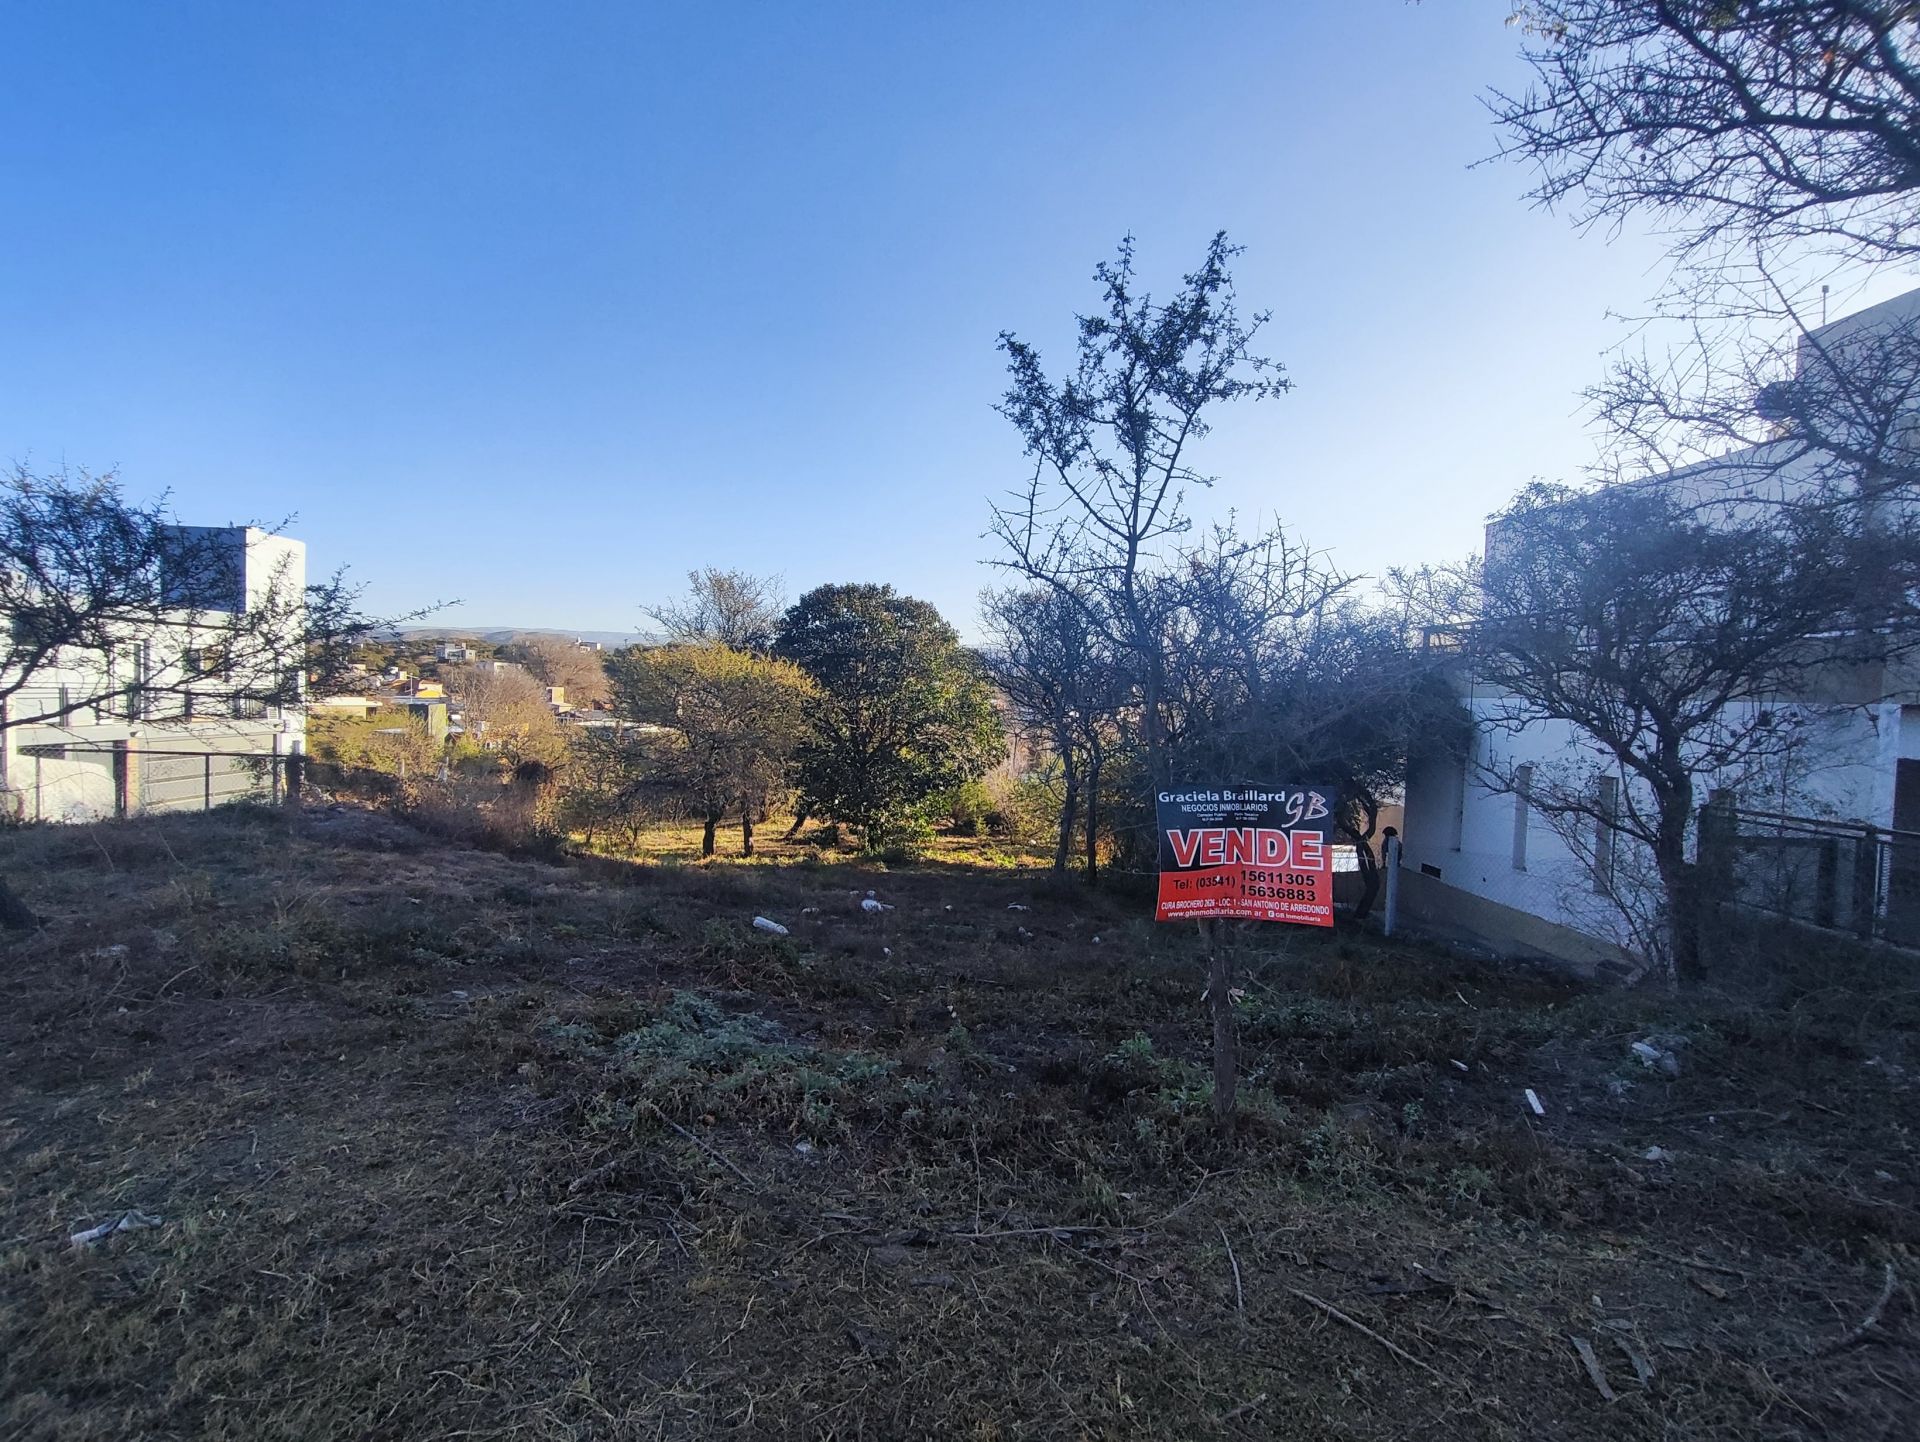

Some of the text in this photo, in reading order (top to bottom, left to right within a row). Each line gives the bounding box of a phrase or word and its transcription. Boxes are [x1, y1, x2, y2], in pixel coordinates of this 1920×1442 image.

[1159, 790, 1285, 802] Graciela Braillard
[1181, 804, 1218, 812] NEGOCIOS
[1282, 791, 1329, 827] GB
[1167, 827, 1324, 870] VENDE
[1173, 870, 1315, 891] Tel: (03541) 15611305
[1240, 885, 1316, 901] 15636883
[1161, 901, 1175, 910] CURA
[1176, 899, 1203, 909] BROCHERO
[1241, 898, 1253, 907] SAN
[1253, 900, 1280, 910] ANTONIO
[1280, 902, 1289, 911] DE
[1290, 903, 1329, 915] ARREDONDO
[1167, 906, 1262, 918] www.gbinmobiliaria.comar
